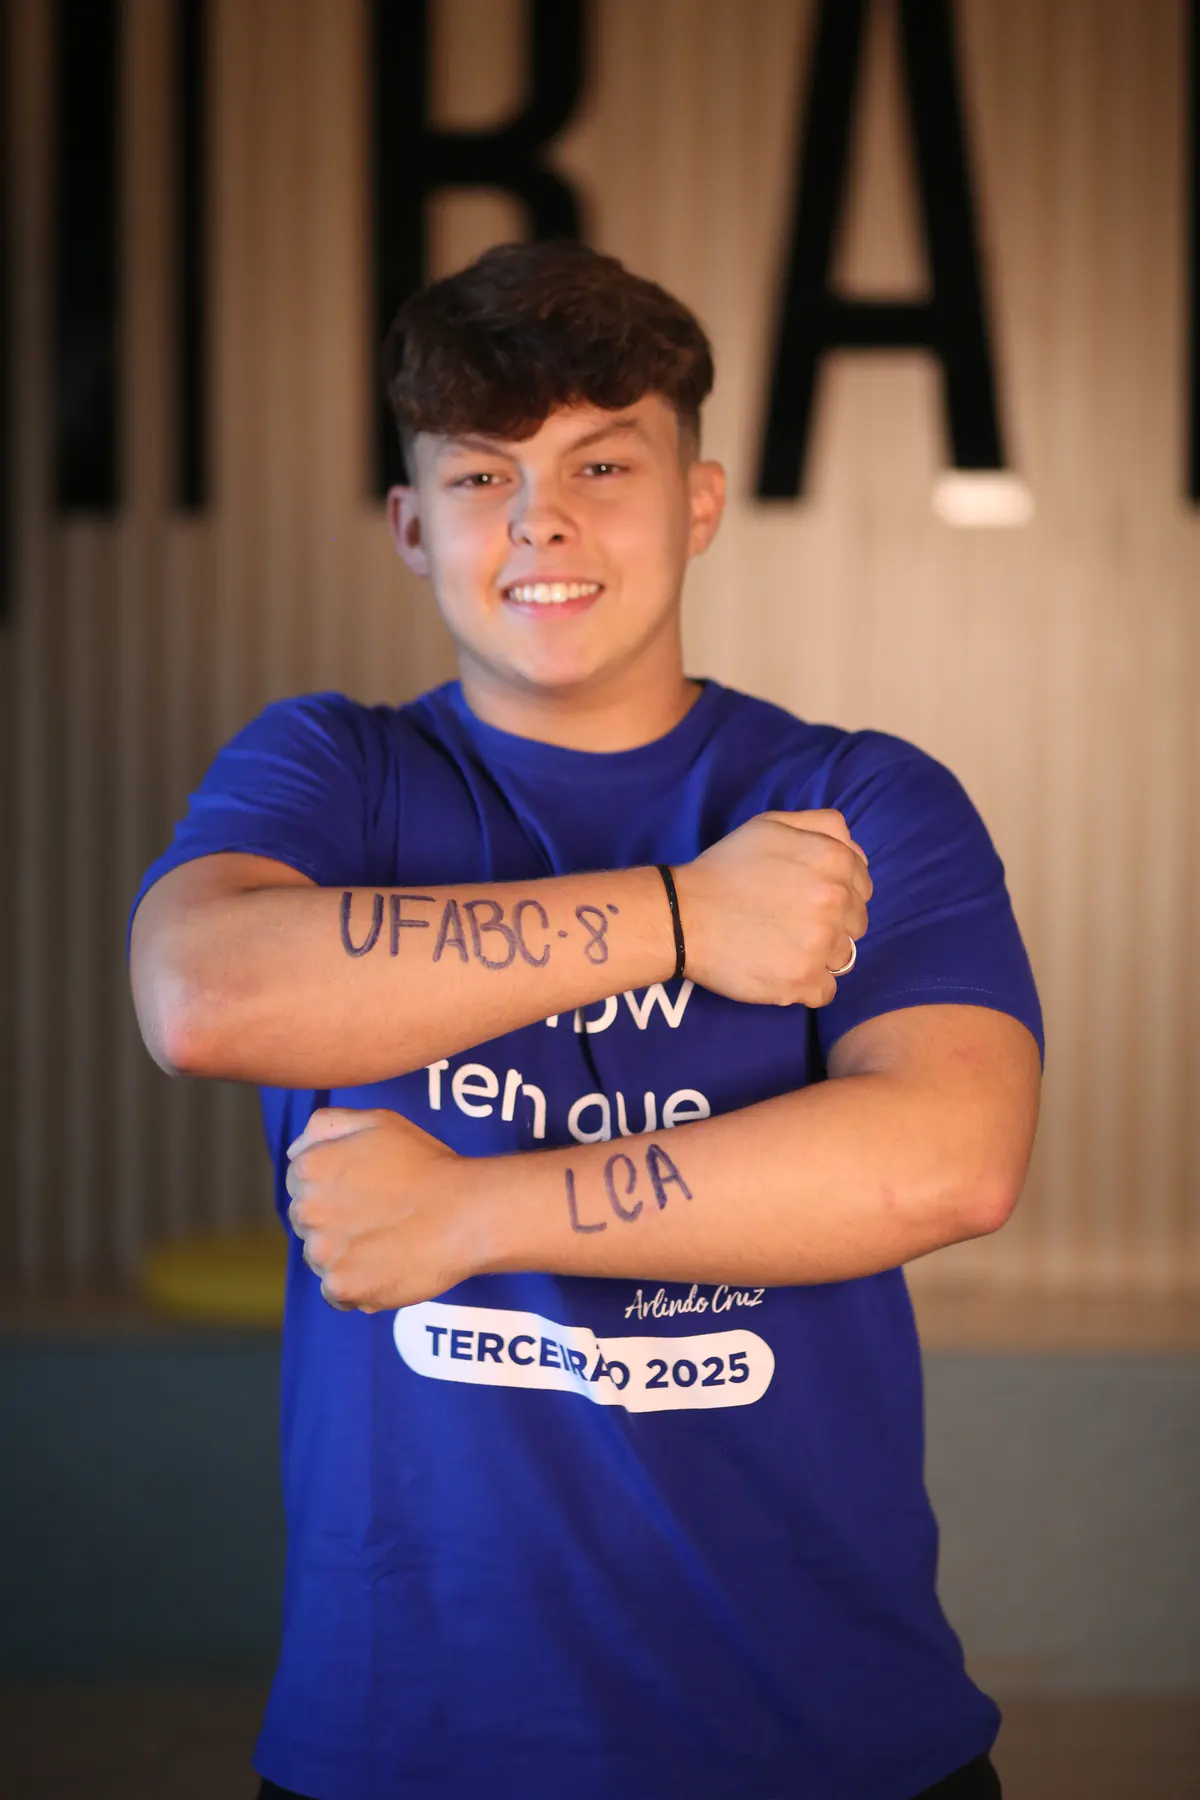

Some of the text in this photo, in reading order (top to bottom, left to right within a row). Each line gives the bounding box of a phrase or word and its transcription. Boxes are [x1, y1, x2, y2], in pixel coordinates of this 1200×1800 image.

[565, 1143, 693, 1234] LCA
[624, 1284, 766, 1320] Arlindo Cruz
[645, 1351, 750, 1389] 2025
